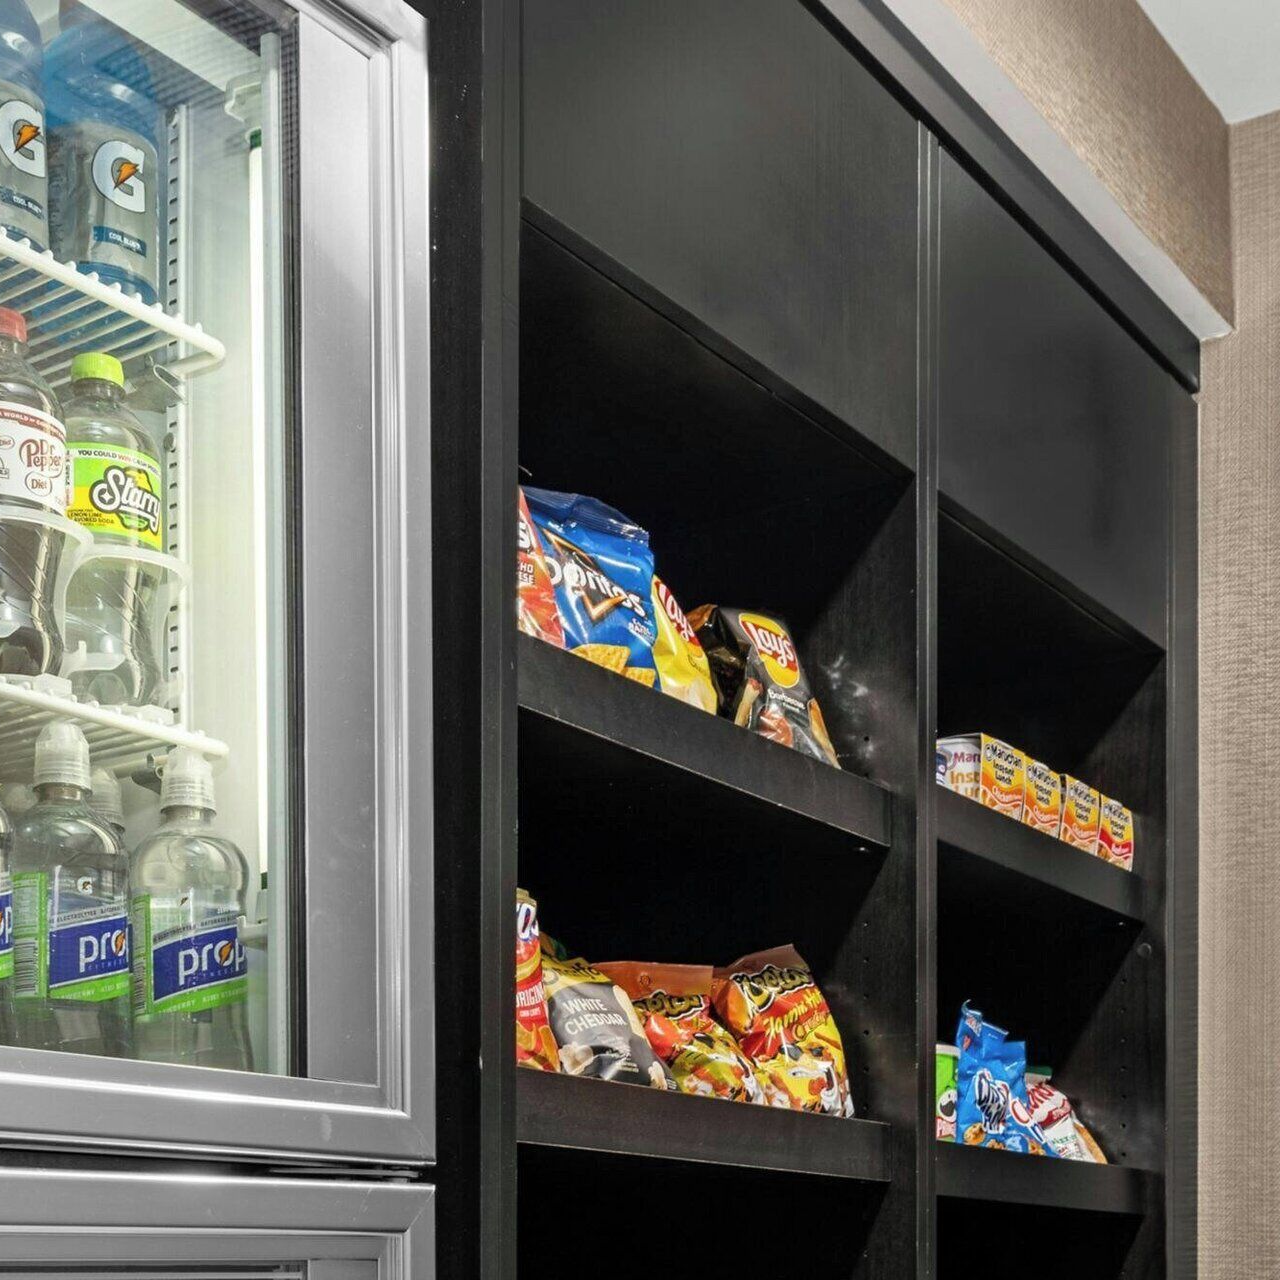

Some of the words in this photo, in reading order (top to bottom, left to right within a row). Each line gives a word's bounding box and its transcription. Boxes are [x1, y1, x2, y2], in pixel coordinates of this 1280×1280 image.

[40, 439, 56, 455] Dr
[94, 450, 117, 459] COULD
[31, 478, 48, 490] Diet
[747, 621, 795, 668] Lay's
[993, 760, 1014, 777] Instant
[563, 998, 609, 1016] WHITE
[564, 1013, 628, 1036] CHEDDAR
